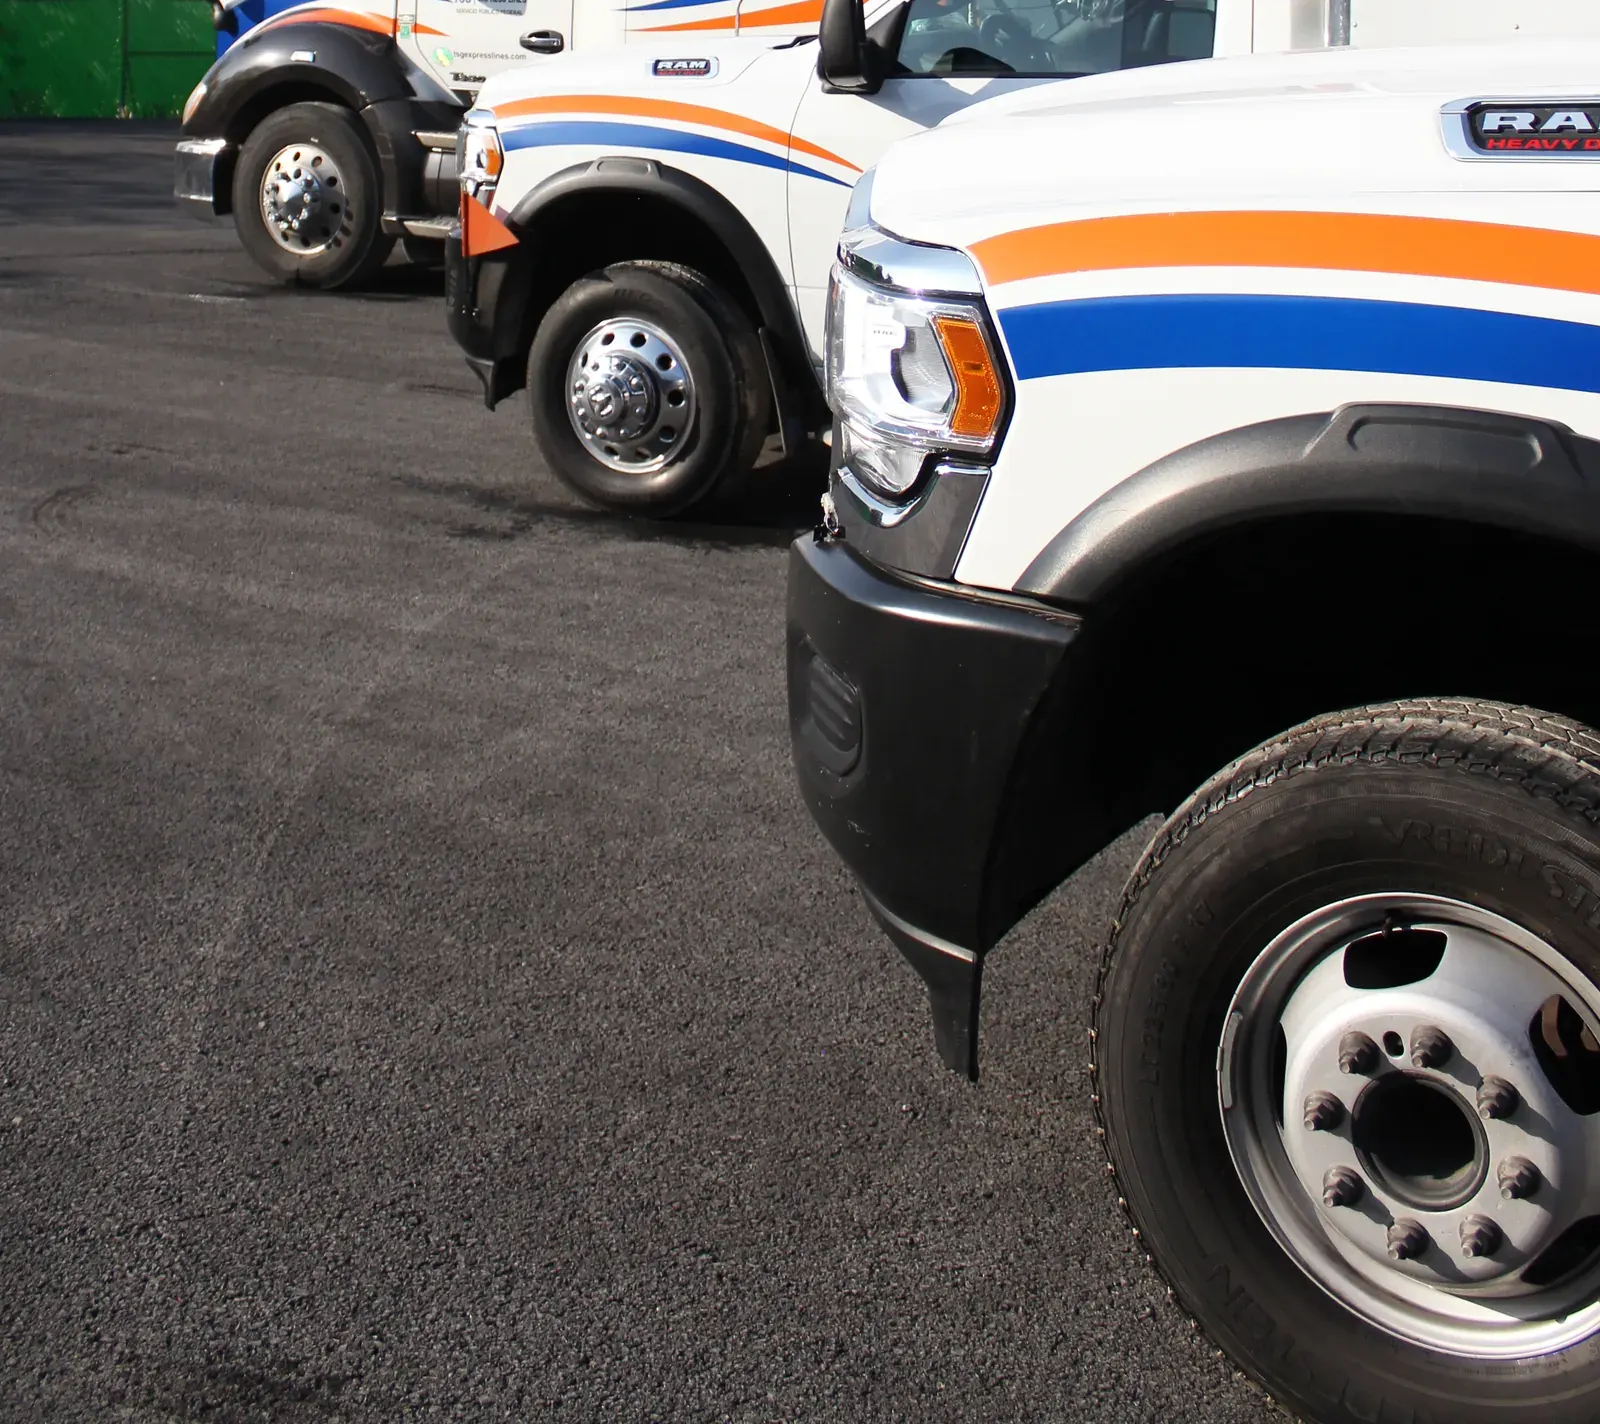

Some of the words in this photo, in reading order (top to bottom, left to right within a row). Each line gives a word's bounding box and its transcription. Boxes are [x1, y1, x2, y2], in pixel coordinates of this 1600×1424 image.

[453, 50, 527, 61] tsgexpresslines.com
[656, 60, 707, 70] RAM
[1482, 111, 1600, 134] RA
[1486, 138, 1579, 150] HEAVY
